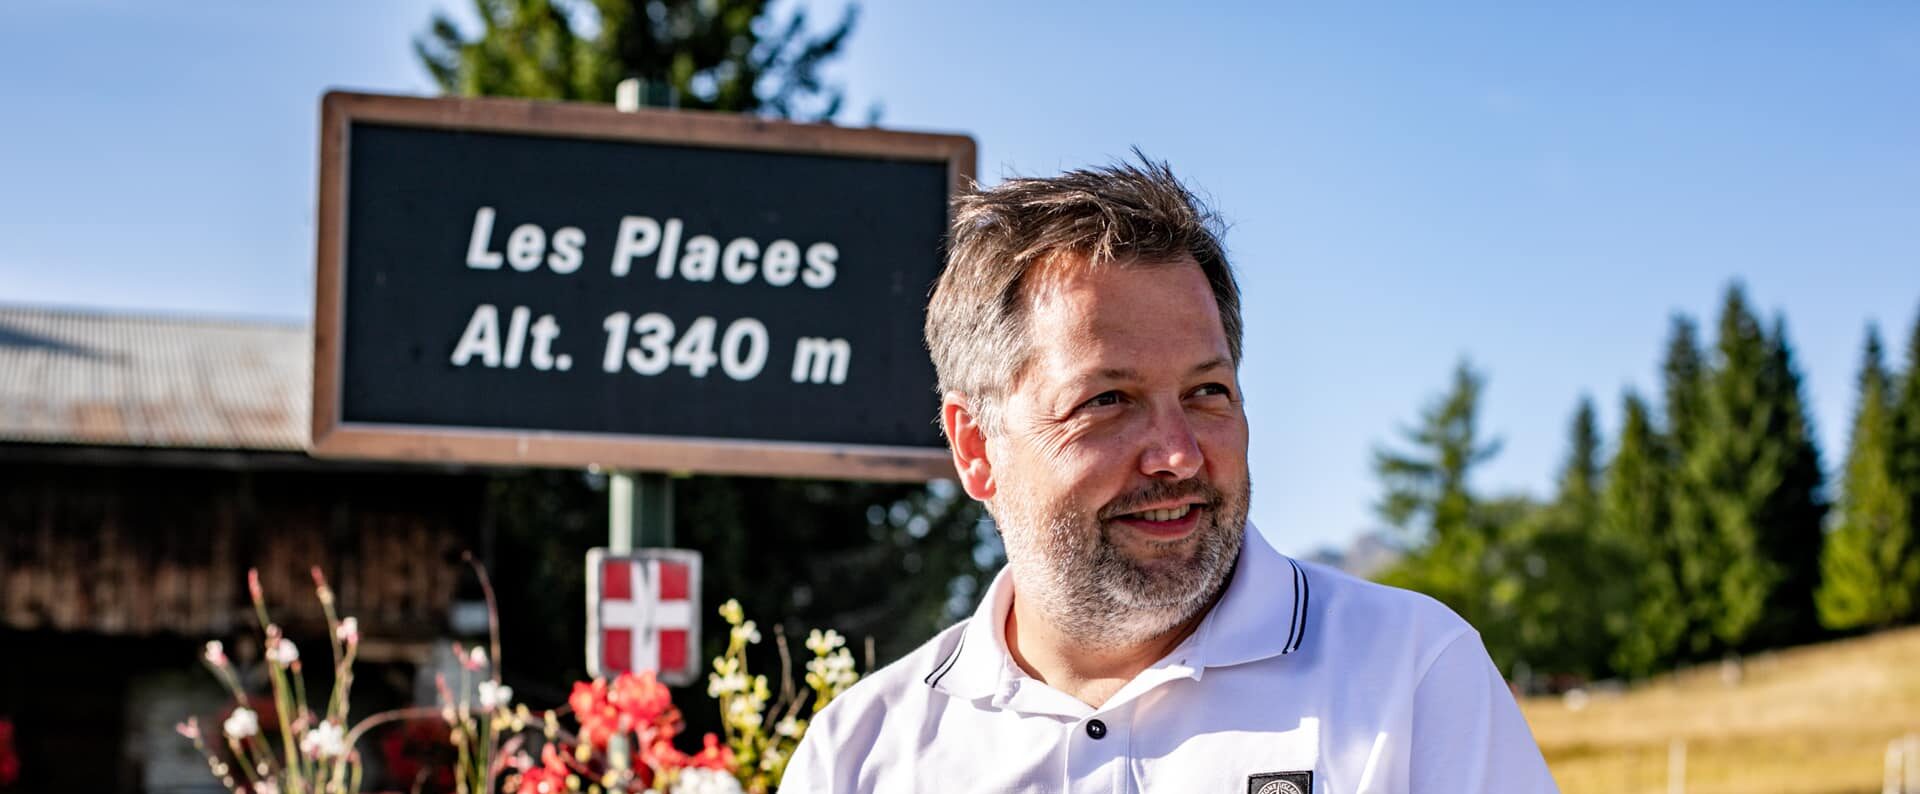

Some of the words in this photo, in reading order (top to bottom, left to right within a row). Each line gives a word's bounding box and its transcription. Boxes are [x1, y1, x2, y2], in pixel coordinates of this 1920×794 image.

[466, 207, 586, 274] Les
[611, 216, 838, 288] Places
[451, 304, 572, 373] Alt.
[603, 311, 769, 381] 1340
[791, 337, 851, 385] m
